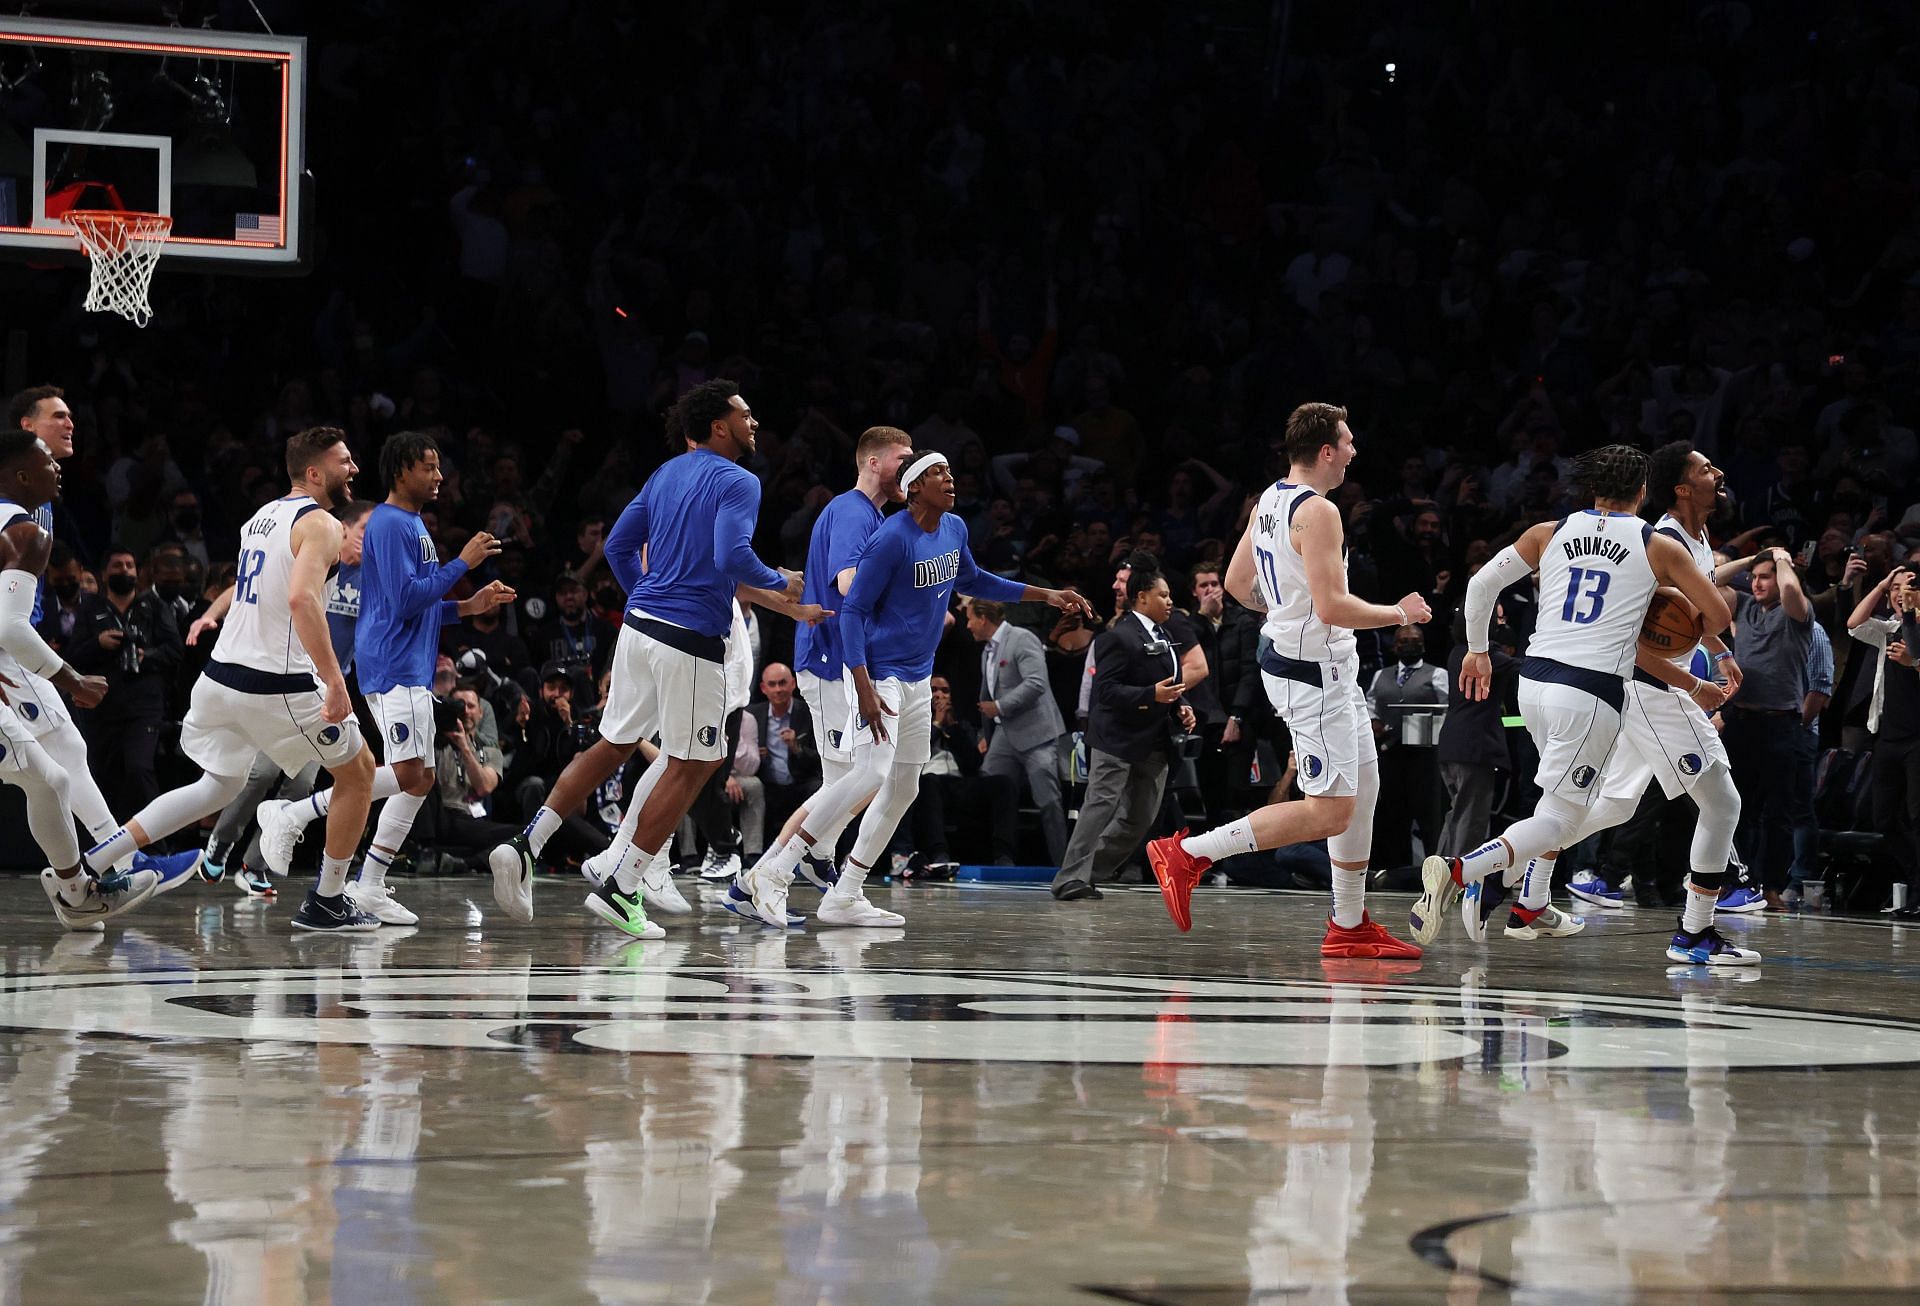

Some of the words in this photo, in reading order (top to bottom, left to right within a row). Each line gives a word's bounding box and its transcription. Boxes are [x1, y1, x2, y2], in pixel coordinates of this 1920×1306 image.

[236, 548, 266, 604] 42
[914, 549, 960, 588] DALLAS
[1256, 545, 1282, 605] 77
[1563, 536, 1631, 566] BRUNSON
[1561, 566, 1611, 624] 13
